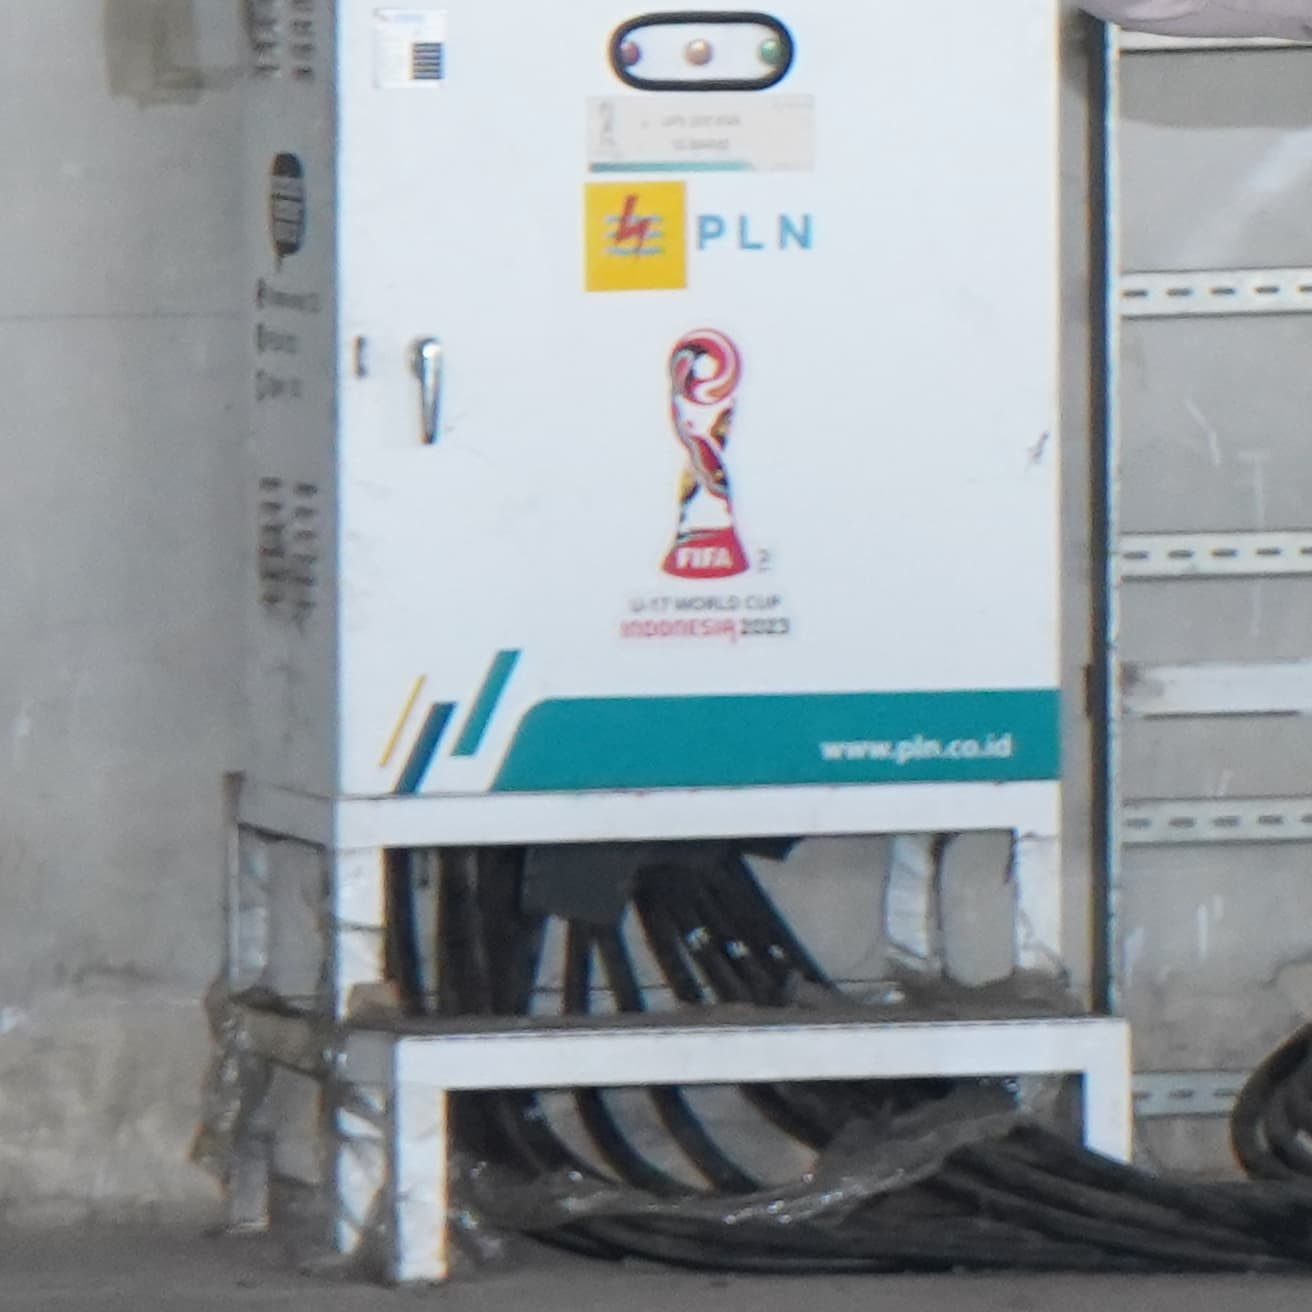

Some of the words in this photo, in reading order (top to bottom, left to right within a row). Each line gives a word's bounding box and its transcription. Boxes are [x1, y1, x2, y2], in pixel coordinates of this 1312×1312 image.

[696, 213, 816, 250] PLN
[675, 546, 735, 569] FIFA
[674, 594, 740, 610] WORLD
[745, 593, 782, 609] CUP
[619, 618, 738, 643] INDONESIA
[819, 733, 1012, 765] www.pln.co.id
